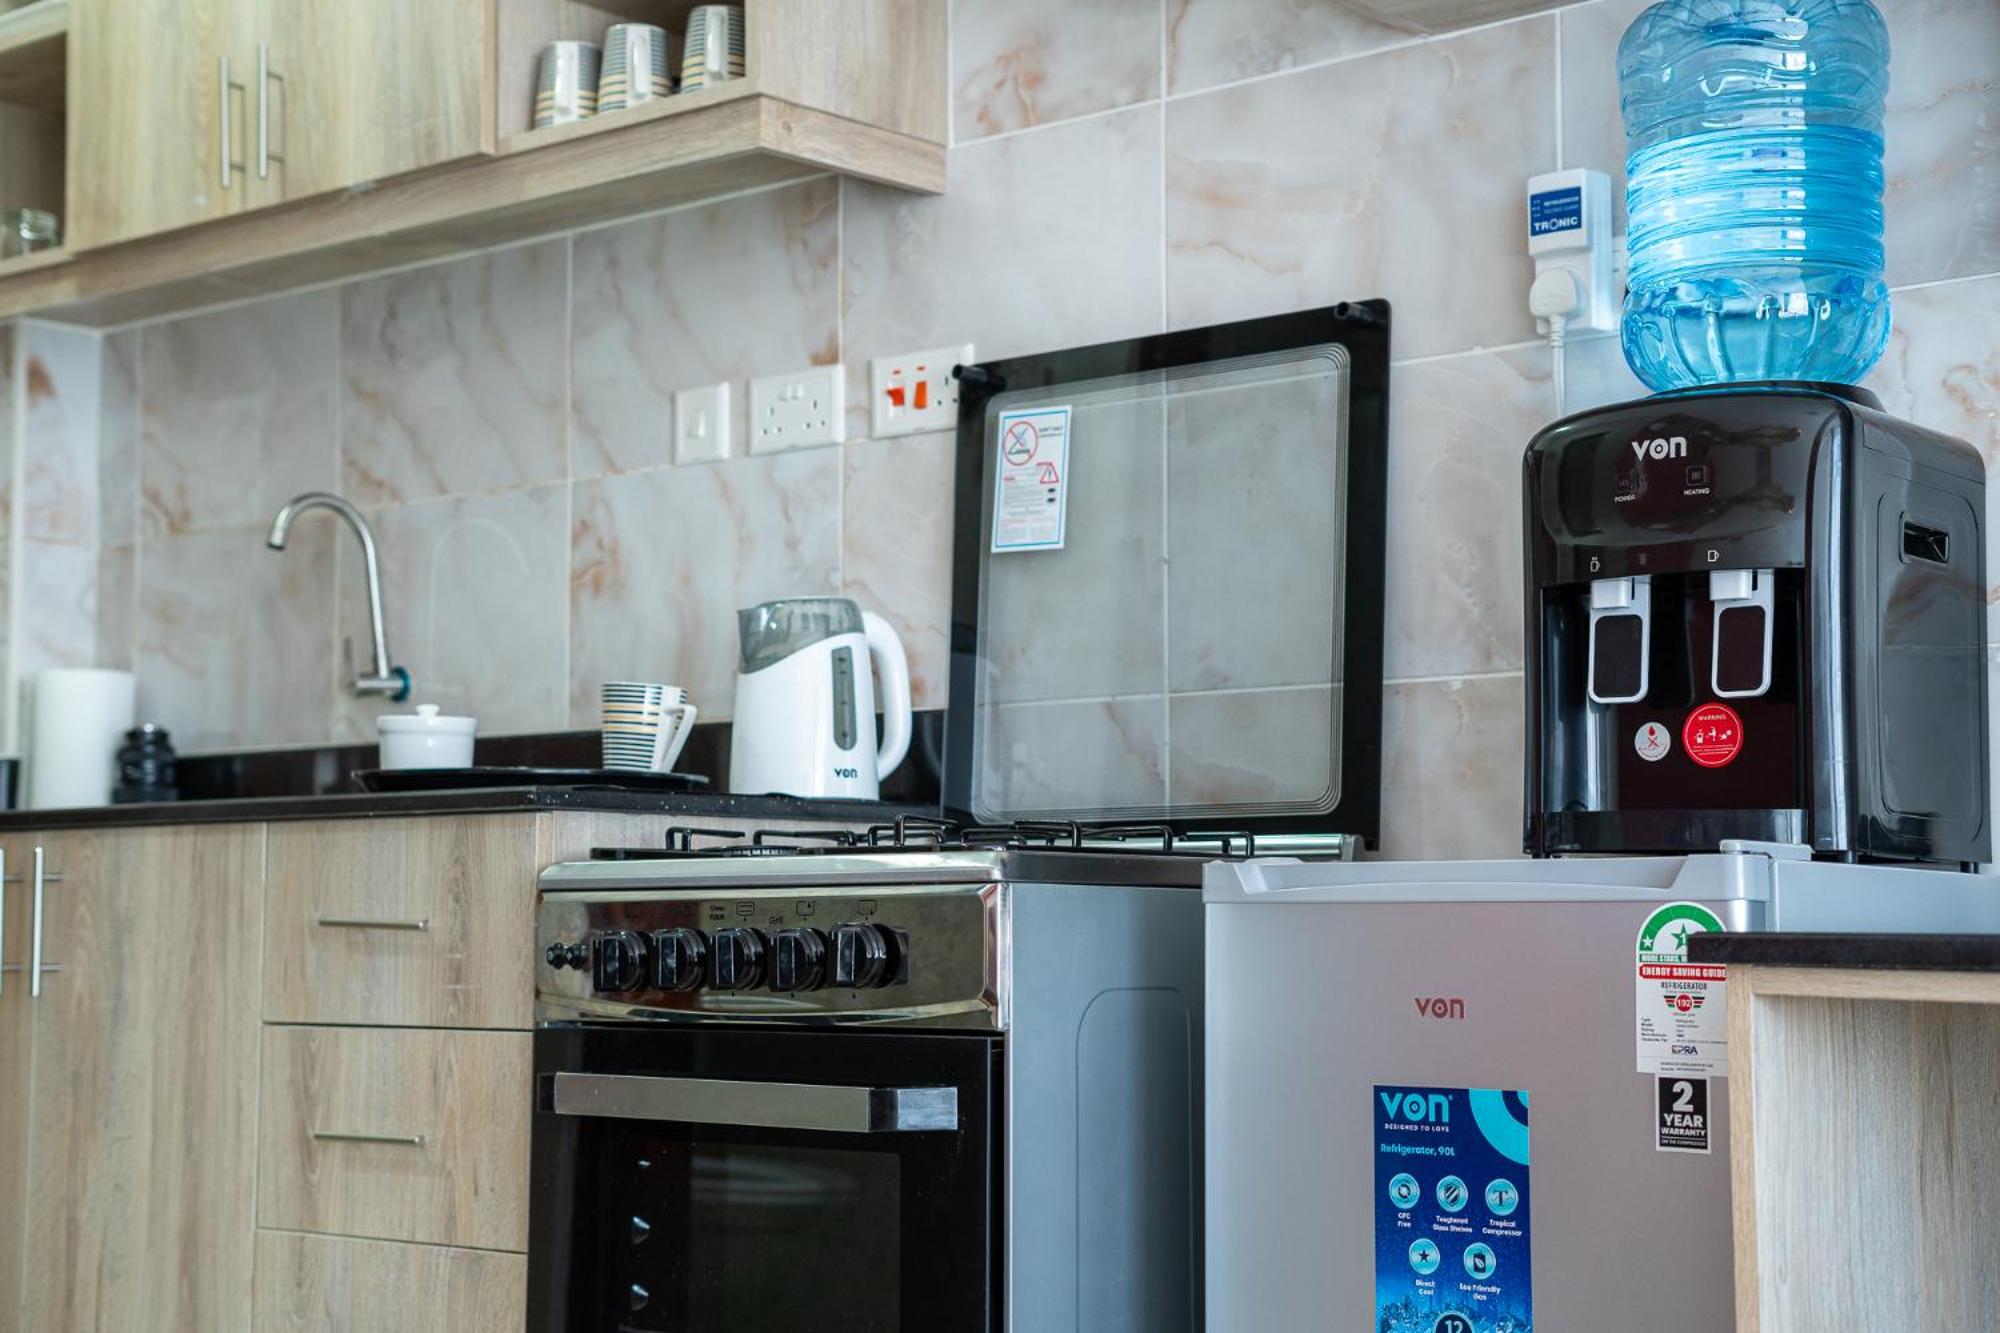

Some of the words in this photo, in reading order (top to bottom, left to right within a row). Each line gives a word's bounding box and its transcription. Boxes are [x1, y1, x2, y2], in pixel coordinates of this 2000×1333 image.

[1533, 216, 1578, 231] TRONIC
[1642, 967, 1671, 976] ENERGY
[1672, 967, 1701, 977] SAVING
[1702, 968, 1728, 978] GUIDE
[1661, 982, 1708, 990] REFRIGERATOR
[1671, 1044, 1698, 1055] EPRA
[1672, 1080, 1694, 1113] 2
[1663, 1113, 1704, 1128] YEAR
[1384, 1123, 1418, 1131] DESIGNED
[1660, 1127, 1706, 1137] WARRANTY
[1380, 1143, 1437, 1157] Refrigerator,
[1438, 1146, 1456, 1157] 90L
[1397, 1220, 1411, 1228] Free
[1489, 1219, 1517, 1228] Tropical
[1482, 1227, 1522, 1236] Compressor
[1415, 1279, 1435, 1288] Direct
[1418, 1287, 1434, 1295] Cool
[1472, 1284, 1501, 1295] Friendly
[1445, 1320, 1464, 1333] 12
